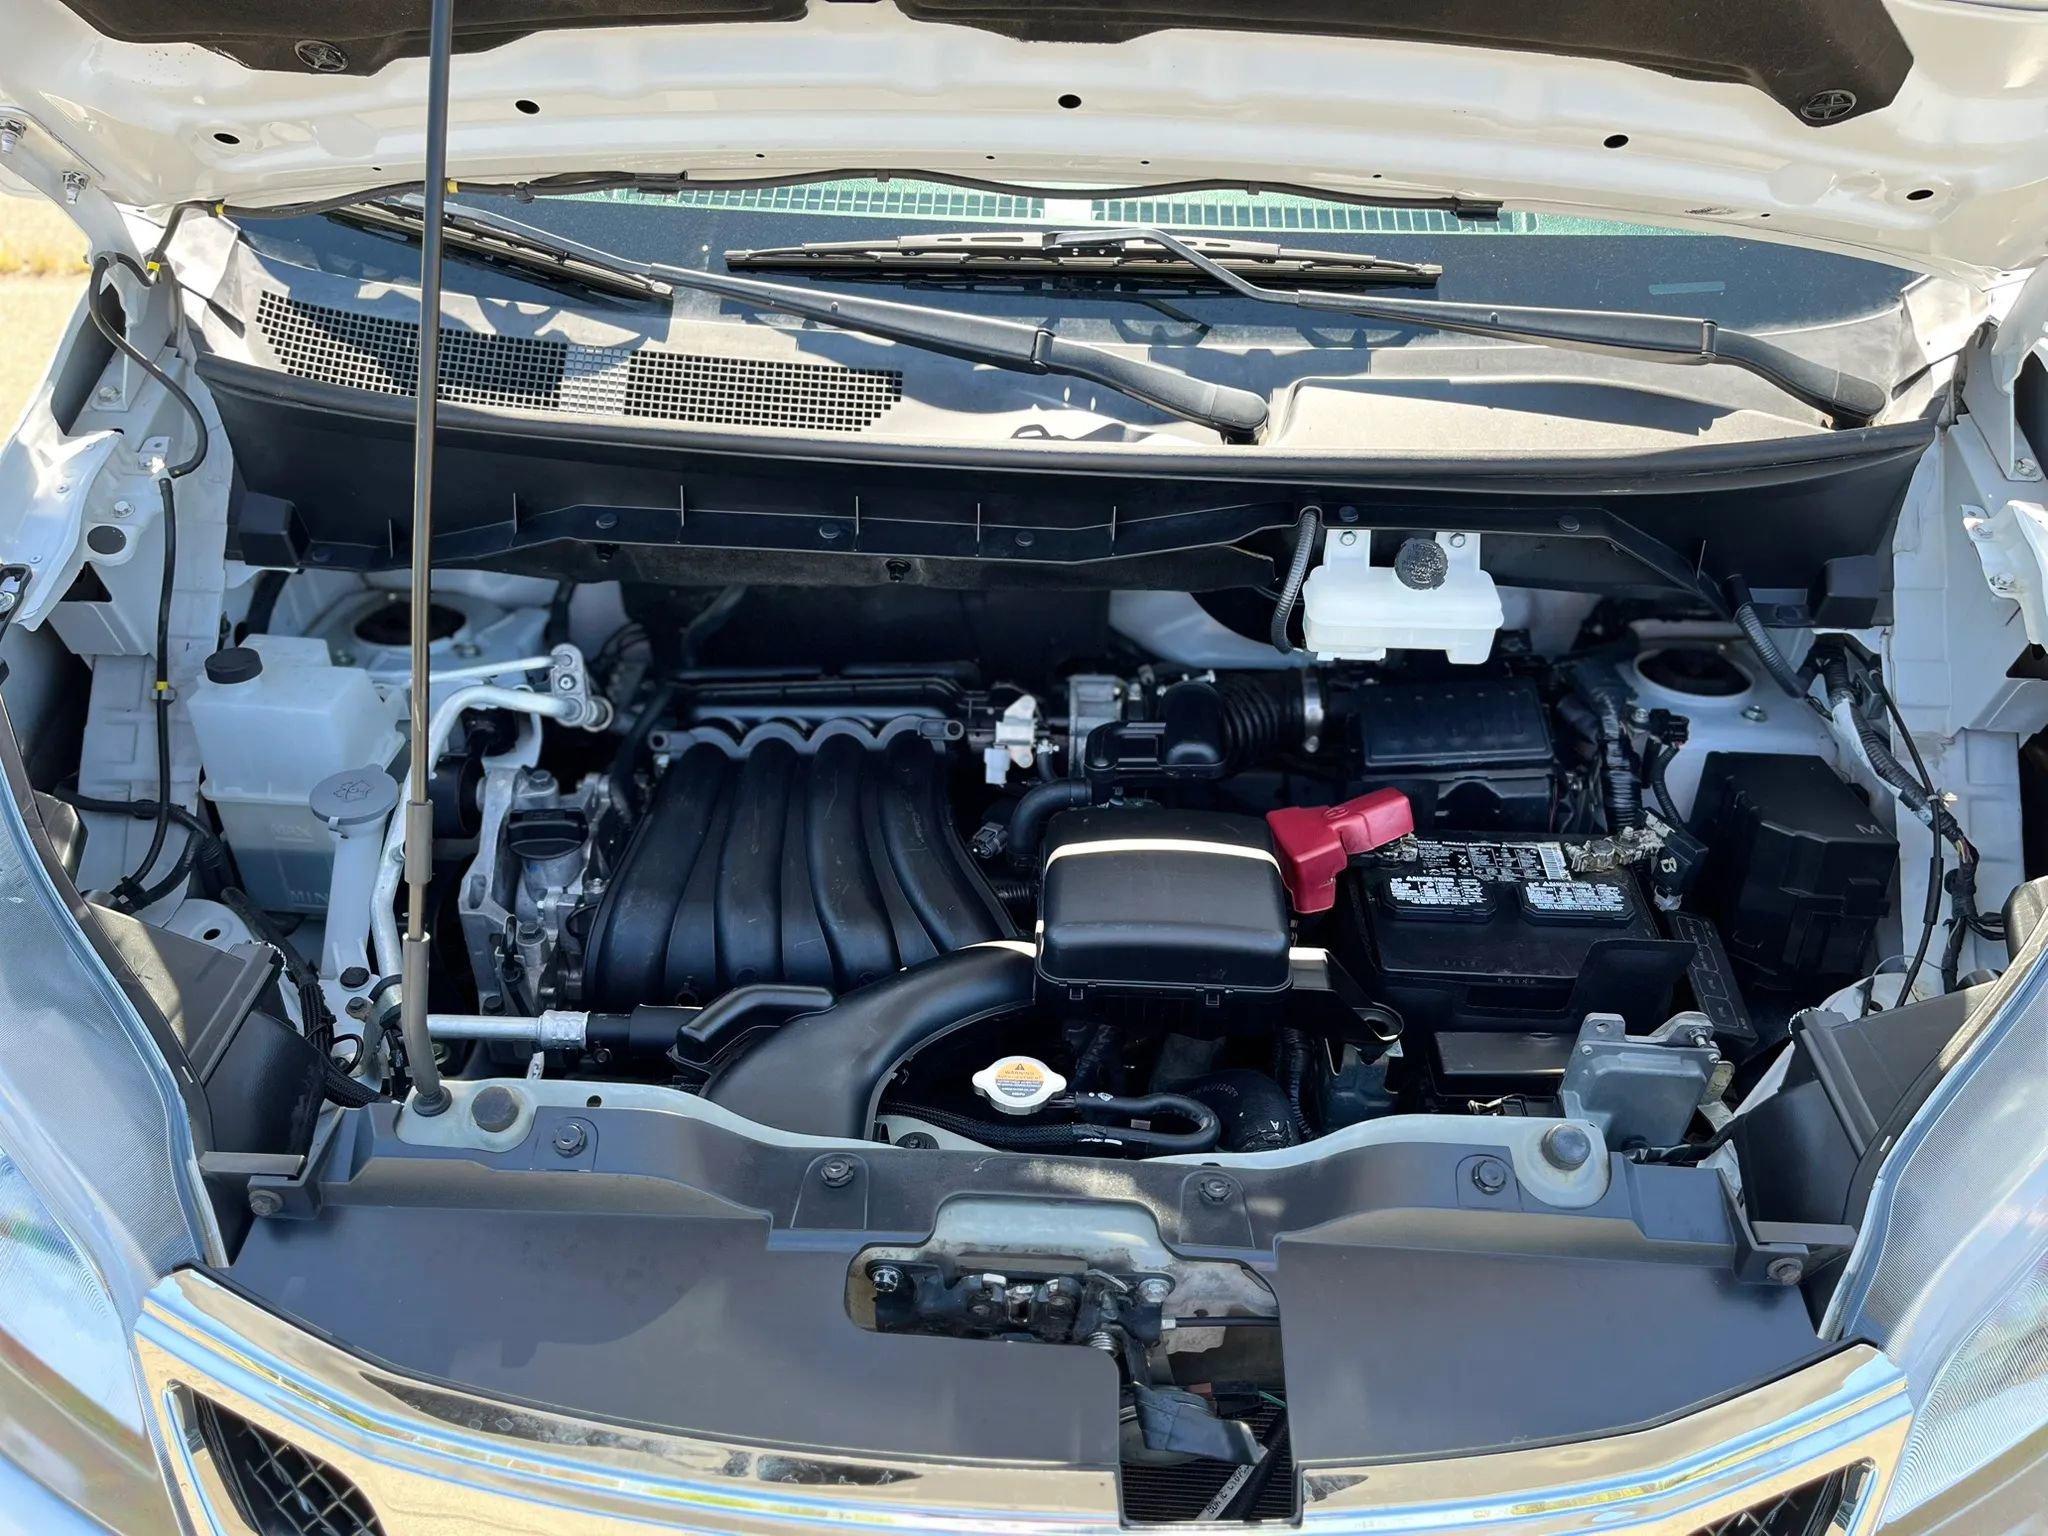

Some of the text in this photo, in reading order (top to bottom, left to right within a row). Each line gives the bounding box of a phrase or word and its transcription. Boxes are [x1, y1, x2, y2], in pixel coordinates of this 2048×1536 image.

[271, 824, 313, 838] MAX
[1855, 823, 1883, 834] M
[1660, 856, 1677, 873] B
[288, 890, 328, 904] MIN
